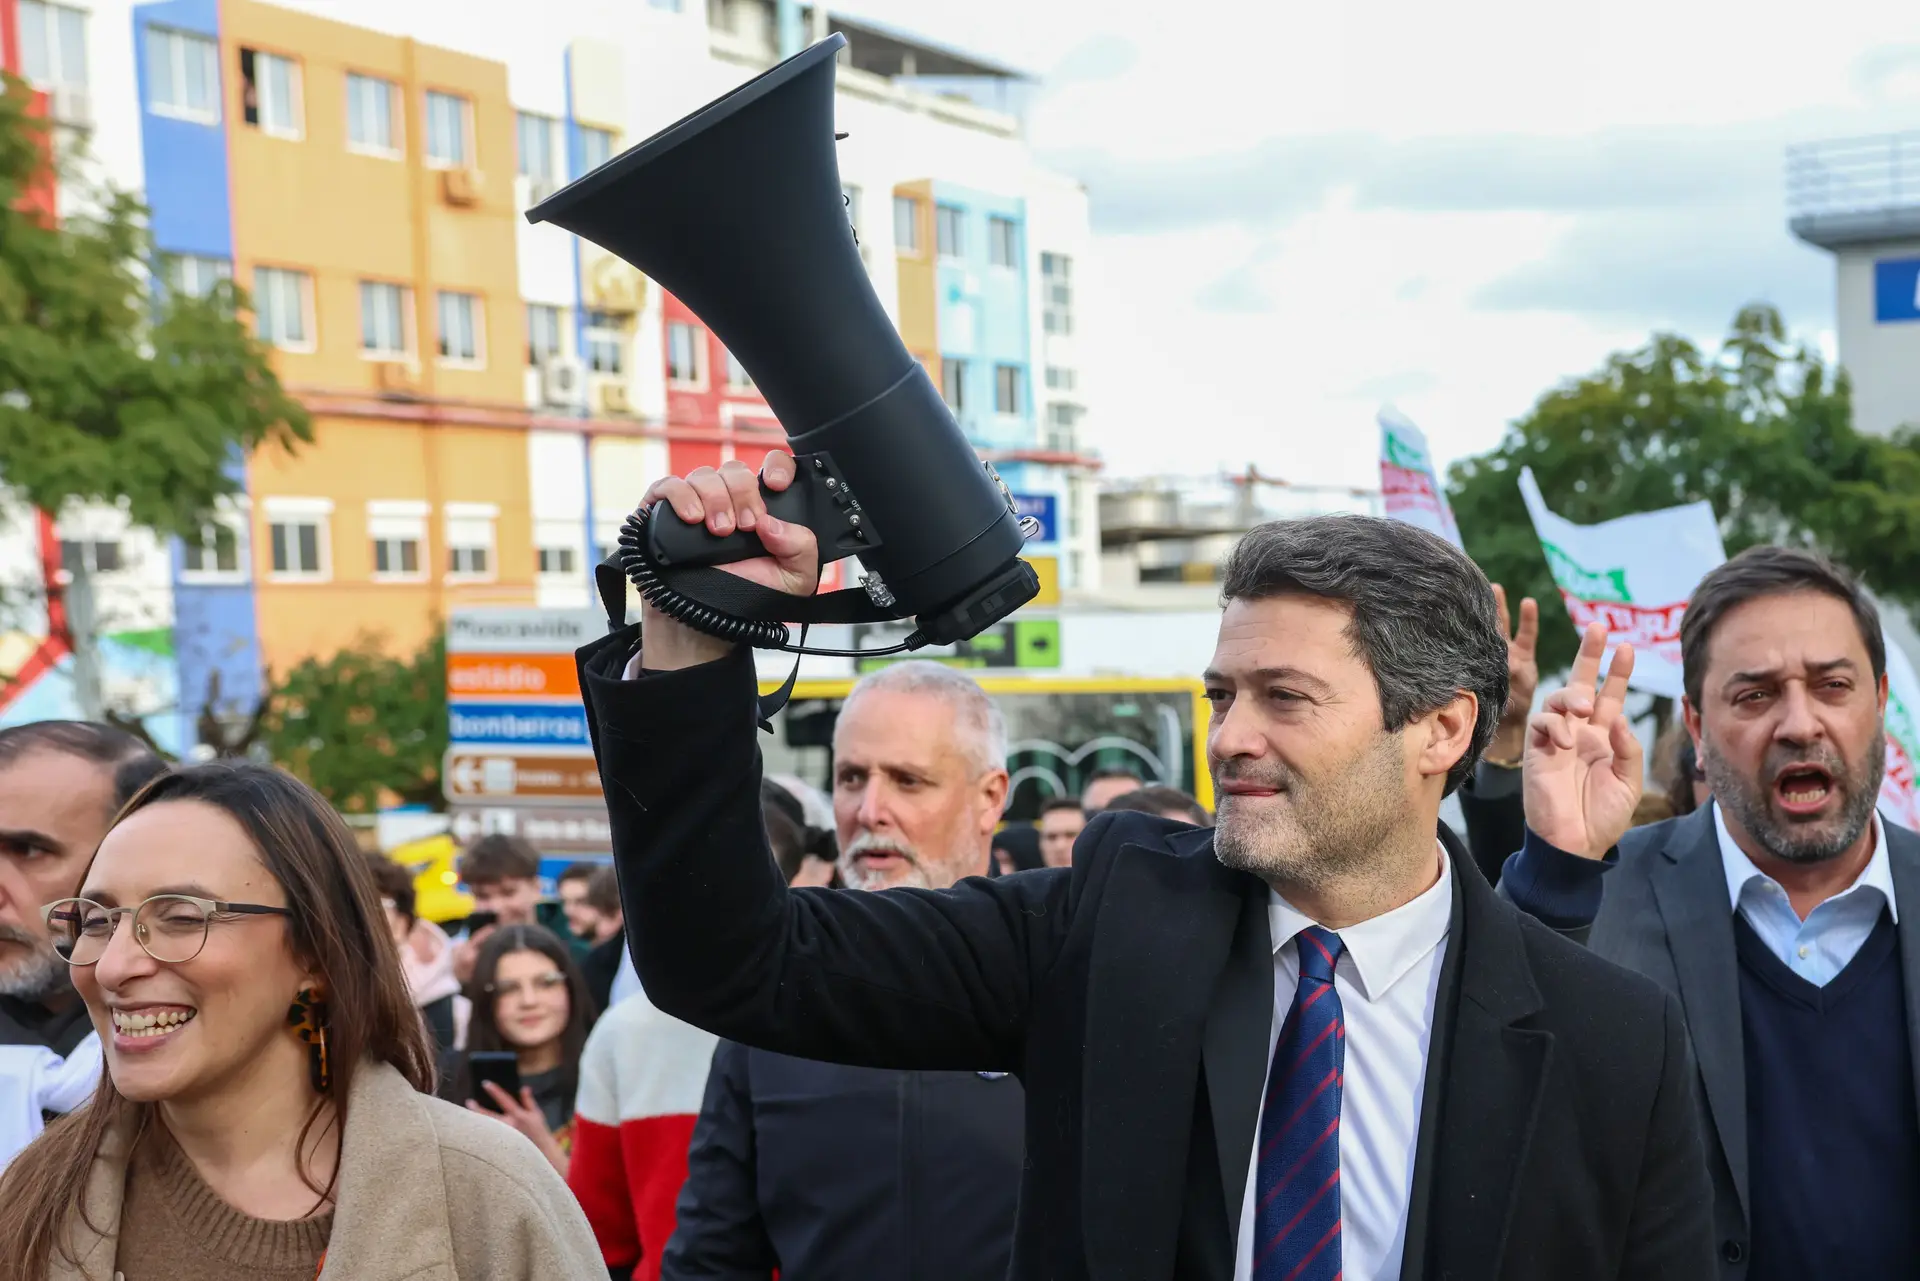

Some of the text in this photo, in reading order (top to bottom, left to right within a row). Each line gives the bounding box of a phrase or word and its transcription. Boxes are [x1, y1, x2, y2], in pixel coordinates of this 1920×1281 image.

[840, 482, 850, 493] ON
[851, 500, 862, 511] OFF
[449, 664, 546, 690] estádio
[450, 712, 582, 739] bombeiros
